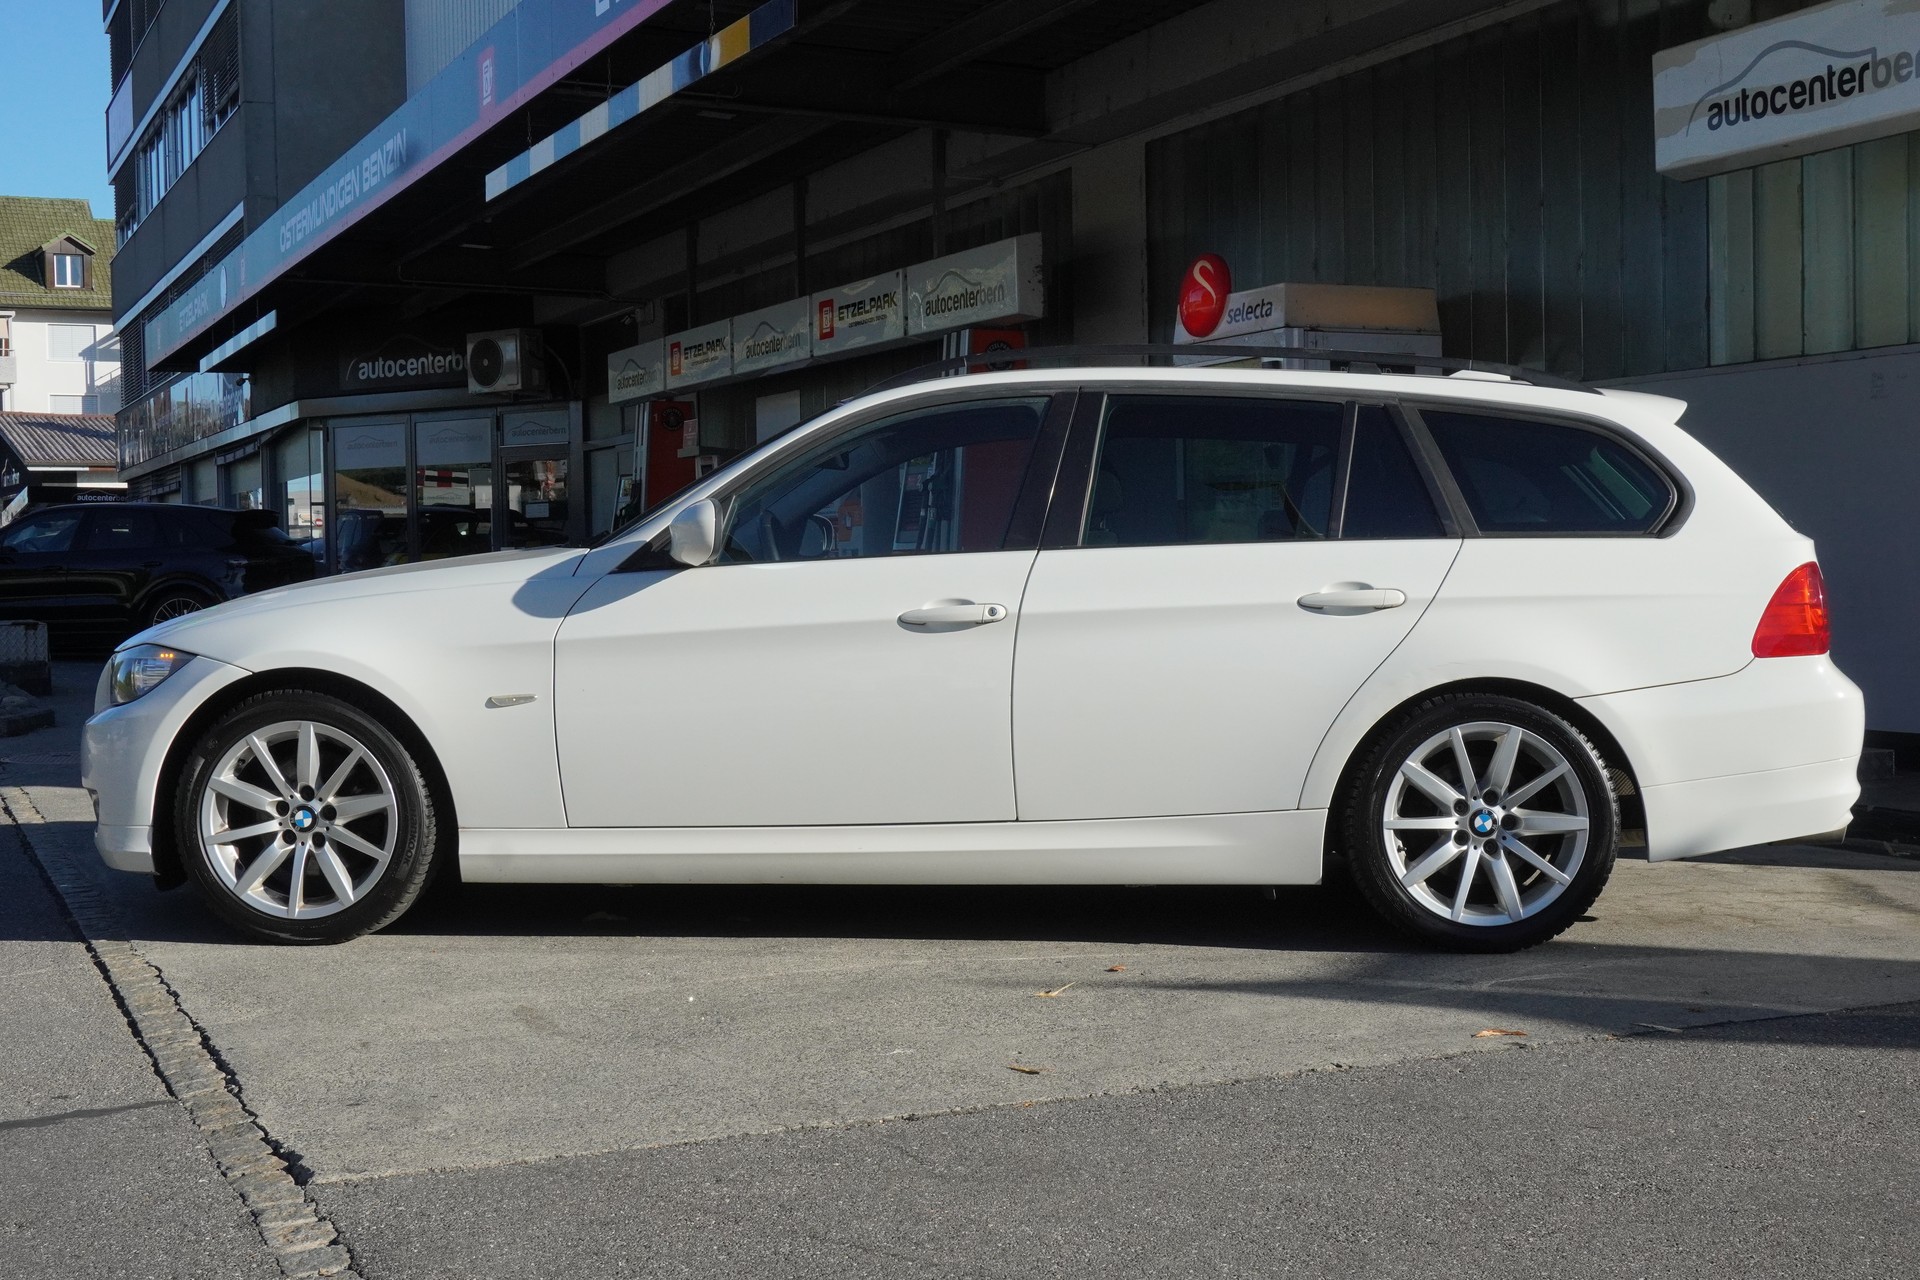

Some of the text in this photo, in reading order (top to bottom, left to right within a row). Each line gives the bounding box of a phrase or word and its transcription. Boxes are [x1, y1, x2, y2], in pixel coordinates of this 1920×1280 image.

[363, 128, 406, 192] BENZIN
[838, 291, 897, 321] ETZELPARK
[926, 282, 1004, 316] autocenterbern
[1227, 298, 1273, 324] selecta
[684, 336, 726, 360] ETZELPARK
[746, 331, 800, 359] autocenterbern
